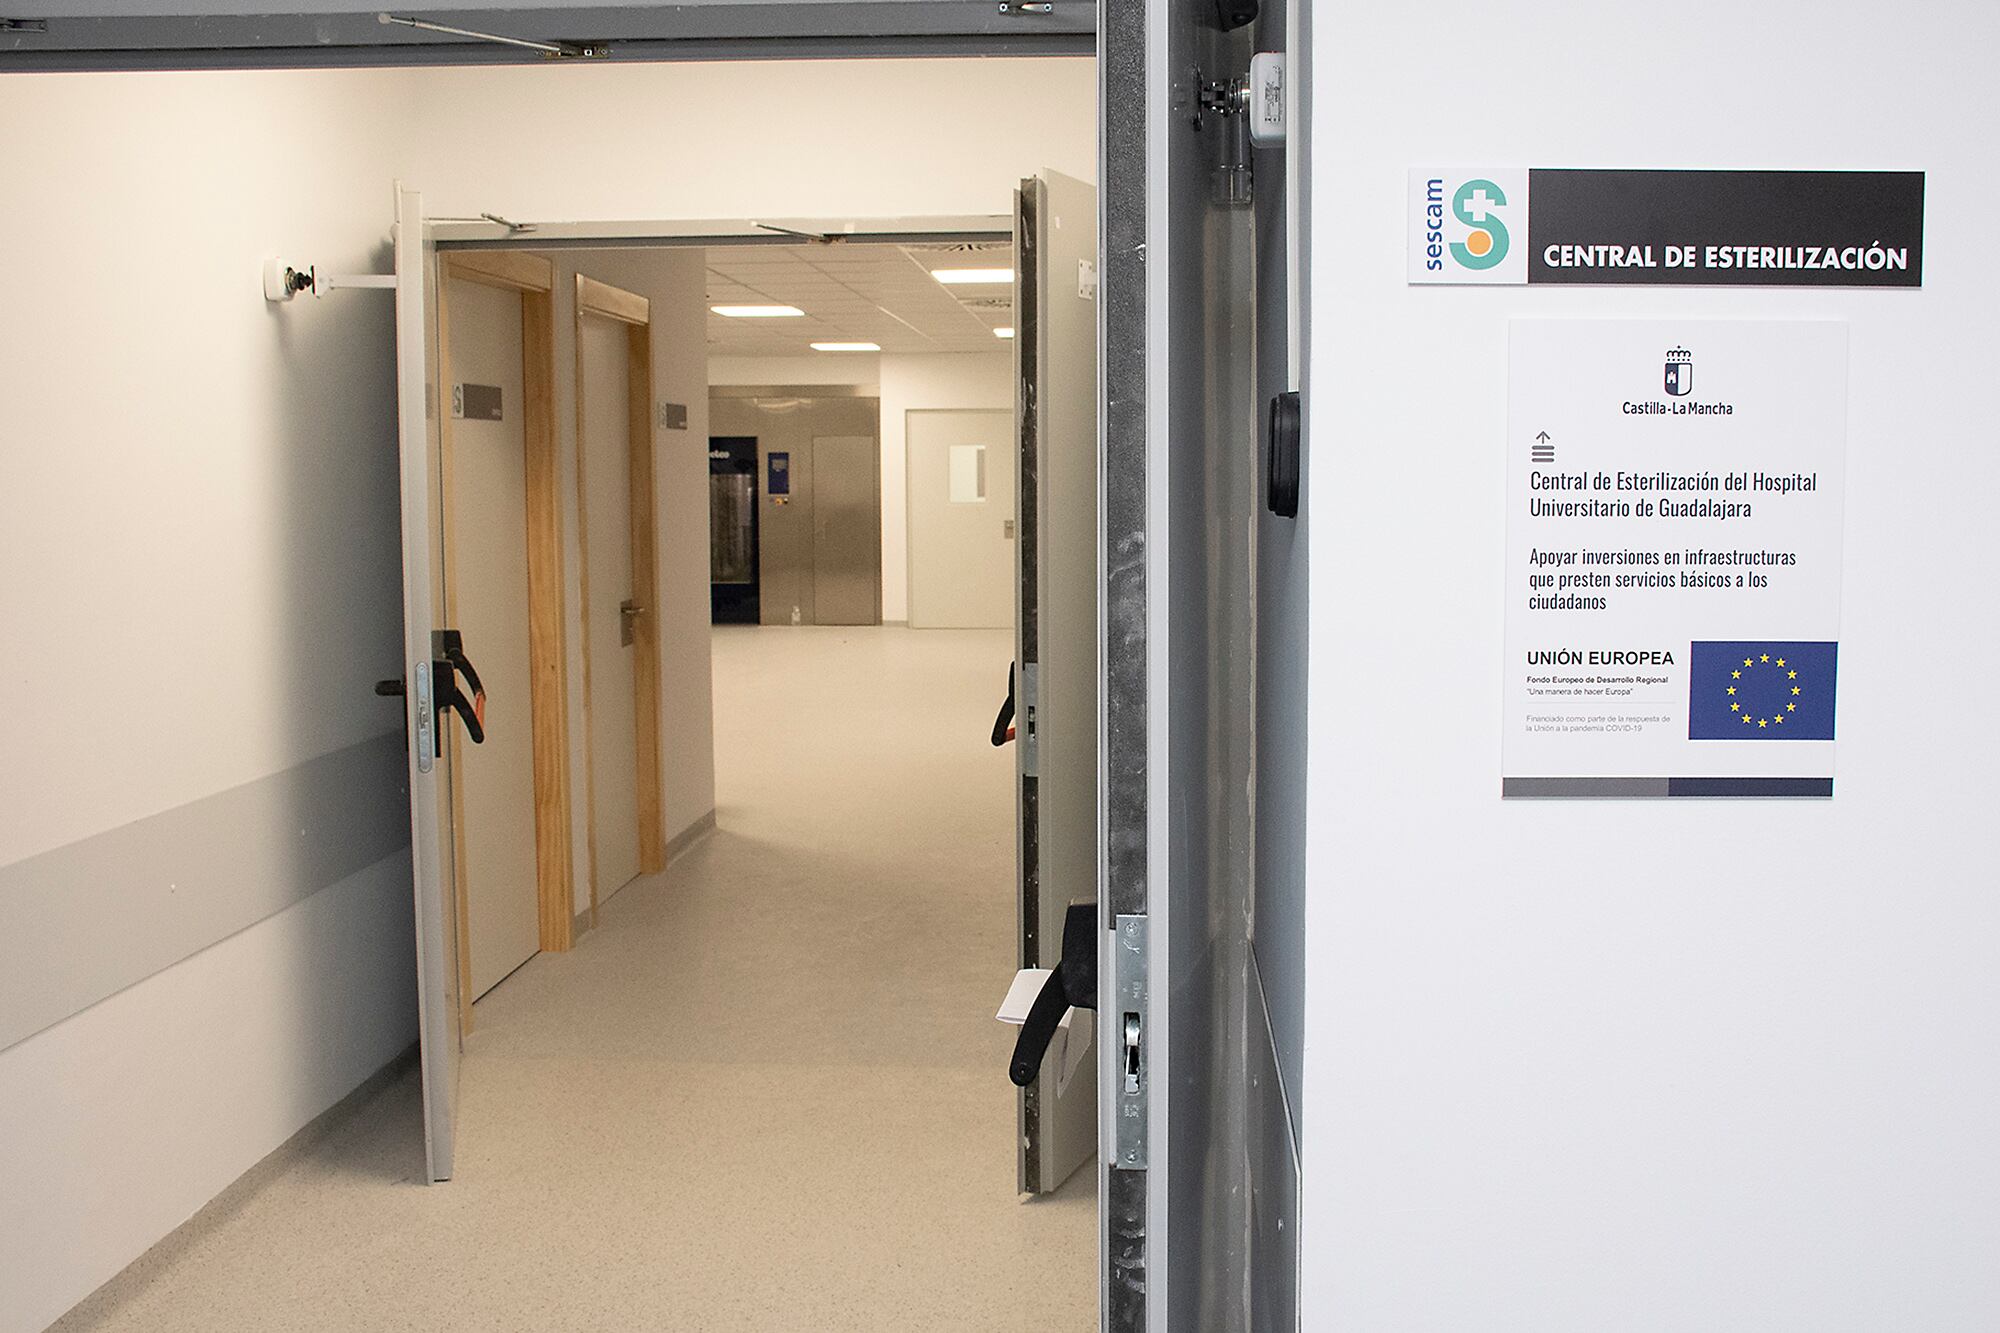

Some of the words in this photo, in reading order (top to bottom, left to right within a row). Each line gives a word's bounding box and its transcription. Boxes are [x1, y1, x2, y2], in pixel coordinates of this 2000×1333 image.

[1425, 178, 1443, 271] sescam
[1544, 244, 1657, 267] CENTRAL
[1665, 246, 1696, 268] DE
[1705, 240, 1907, 270] ESTERILIZACIÓN
[1530, 470, 1588, 491] Central
[1592, 471, 1611, 491] de
[1616, 471, 1719, 491] Esterilización
[1724, 471, 1748, 492] del
[1753, 472, 1817, 496] Hospital
[1530, 497, 1630, 518] Universitario
[1635, 497, 1654, 518] de
[1659, 498, 1752, 521] Guadalajara
[1529, 547, 1578, 569] Apoyar
[1582, 548, 1660, 566] inversiones
[1664, 552, 1680, 566] en
[1685, 548, 1797, 566] infraestructuras
[1529, 574, 1555, 591] que
[1558, 571, 1611, 591] presten
[1615, 571, 1676, 588] servicios
[1680, 569, 1732, 588] básicos
[1735, 574, 1744, 588] a
[1748, 570, 1768, 588] los
[1528, 592, 1607, 610] ciudadanos
[1527, 647, 1583, 666] UNIÓN
[1588, 650, 1675, 666] EUROPEA
[1527, 675, 1550, 684] Fondo
[1552, 675, 1584, 685] Europeo
[1585, 675, 1595, 684] de
[1597, 675, 1634, 684] Desarrollo
[1636, 675, 1668, 686] Regional
[1545, 688, 1572, 696] manera
[1573, 688, 1582, 696] de
[1584, 688, 1604, 696] hacer
